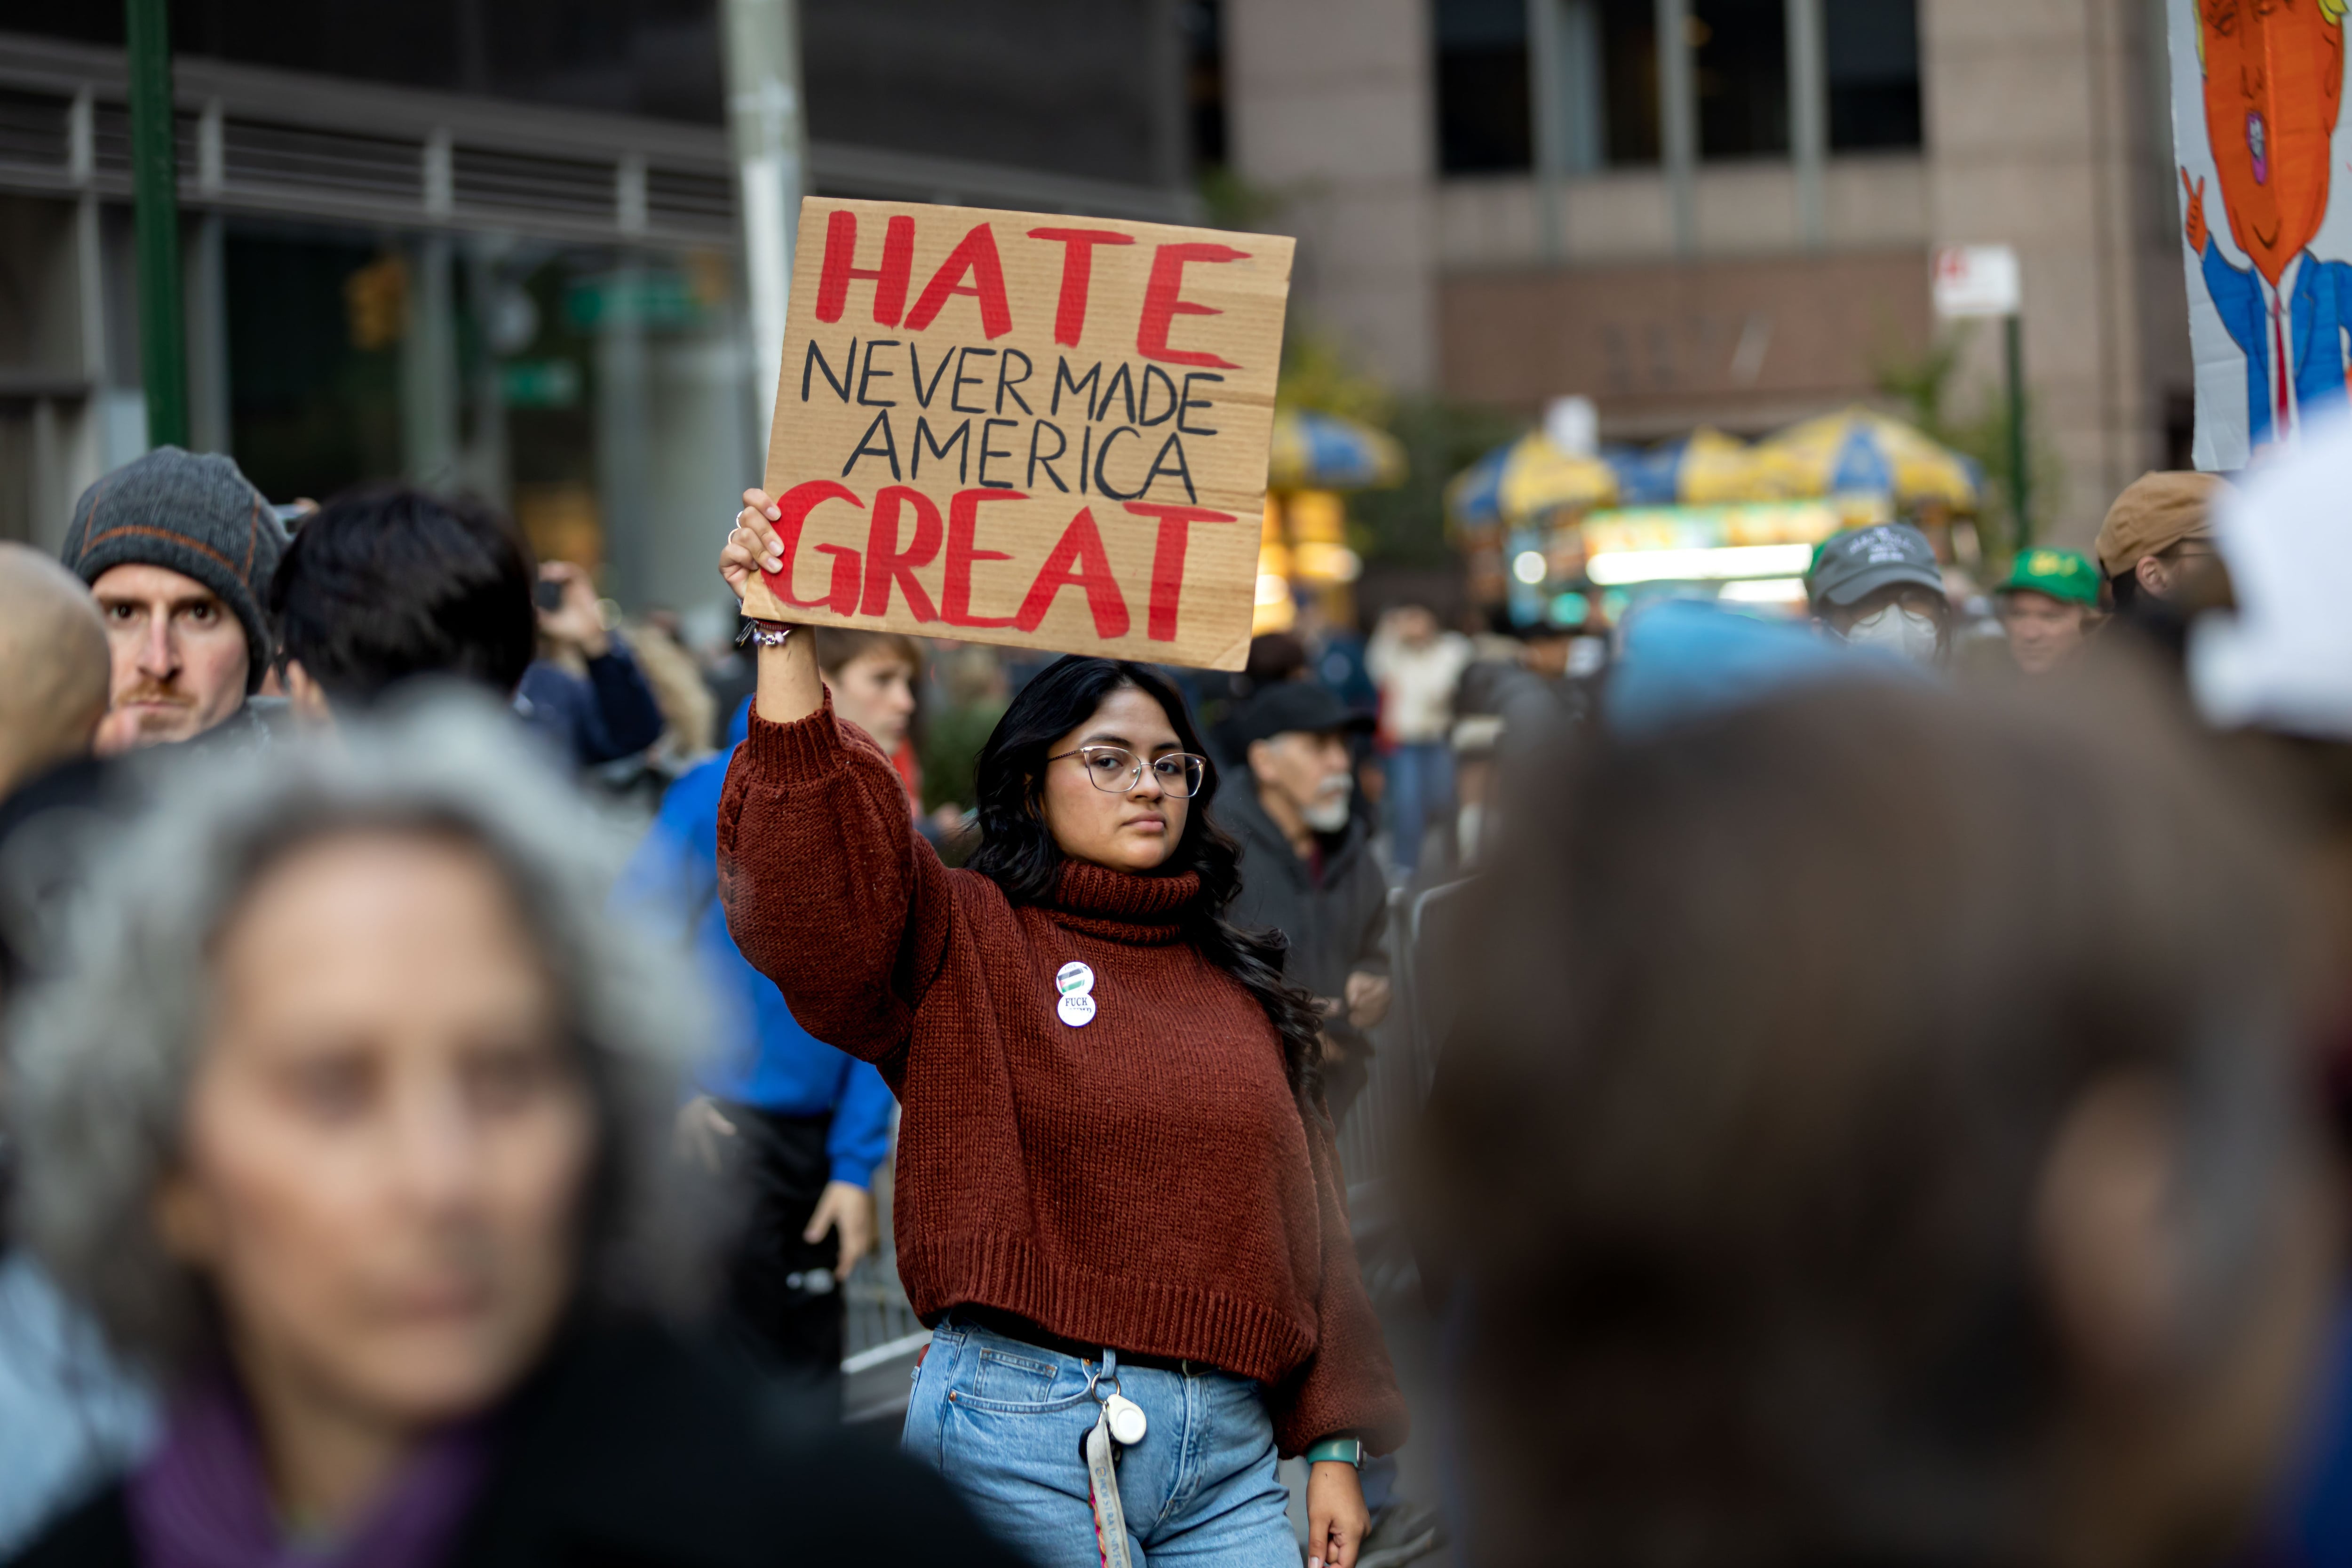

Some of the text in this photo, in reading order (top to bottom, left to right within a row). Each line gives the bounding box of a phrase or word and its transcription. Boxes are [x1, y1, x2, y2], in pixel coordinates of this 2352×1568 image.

[816, 210, 1253, 369] HATE
[802, 336, 1224, 436] NEVER MADE
[842, 408, 1197, 505] AMERICA
[760, 479, 1238, 642] GREAT
[1065, 997, 1088, 1006] FUCK
